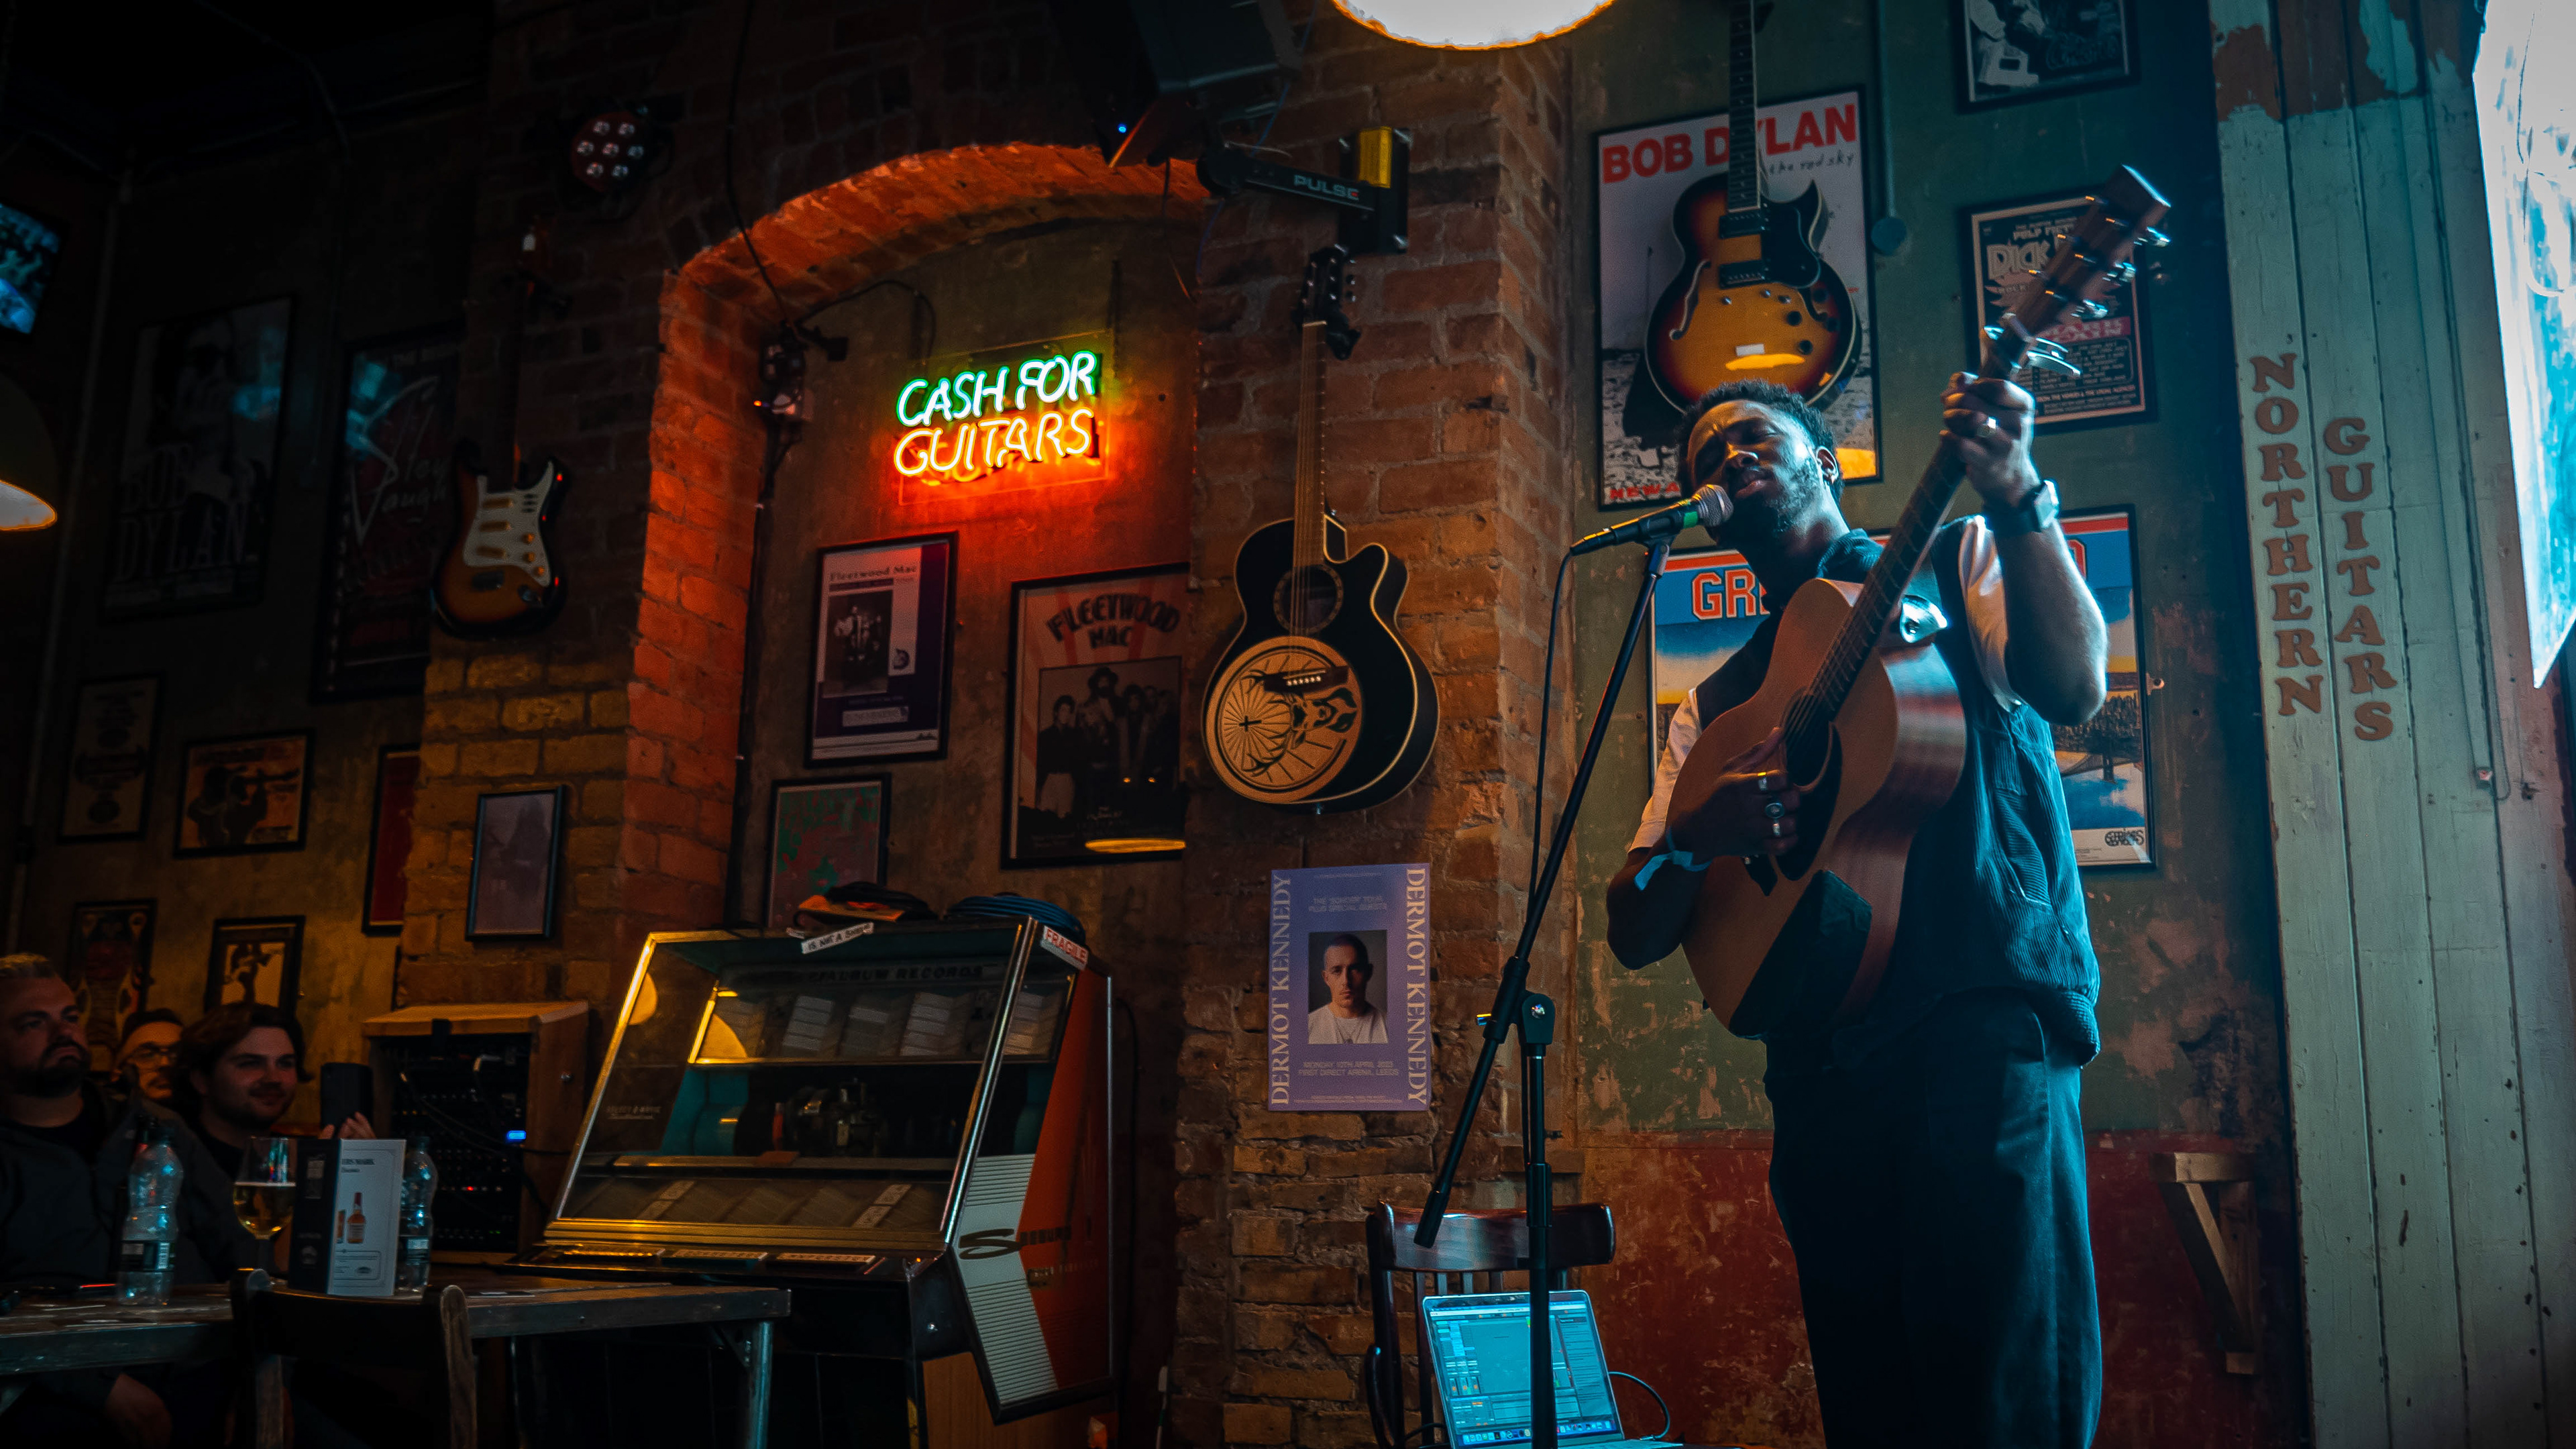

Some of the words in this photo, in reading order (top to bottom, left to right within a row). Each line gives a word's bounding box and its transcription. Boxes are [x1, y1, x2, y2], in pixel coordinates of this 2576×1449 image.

[1602, 133, 1694, 184] BOB
[1705, 104, 1858, 166] DLAN
[1799, 152, 1824, 170] red
[1826, 149, 1855, 168] sky
[1293, 174, 1360, 202] PULSE
[896, 366, 1010, 427] CASH
[1014, 350, 1097, 411] FOR
[894, 407, 1095, 476] GUITARS
[112, 504, 248, 582] DYLAN
[2249, 352, 2323, 716] NORTHERN
[830, 567, 890, 581] Fleetwood
[893, 565, 917, 574] Mac
[2323, 417, 2398, 741] GUITARS
[1046, 593, 1181, 642] FLEETWOOD
[1088, 625, 1133, 649] MAC
[1046, 928, 1087, 964] FRAGILE
[1272, 875, 1291, 991] KENNEDY
[1406, 868, 1426, 977] DERMOT
[896, 966, 983, 981] RECORDS
[1271, 997, 1290, 1105] DERMOT
[1407, 983, 1428, 1104] KENNEDY
